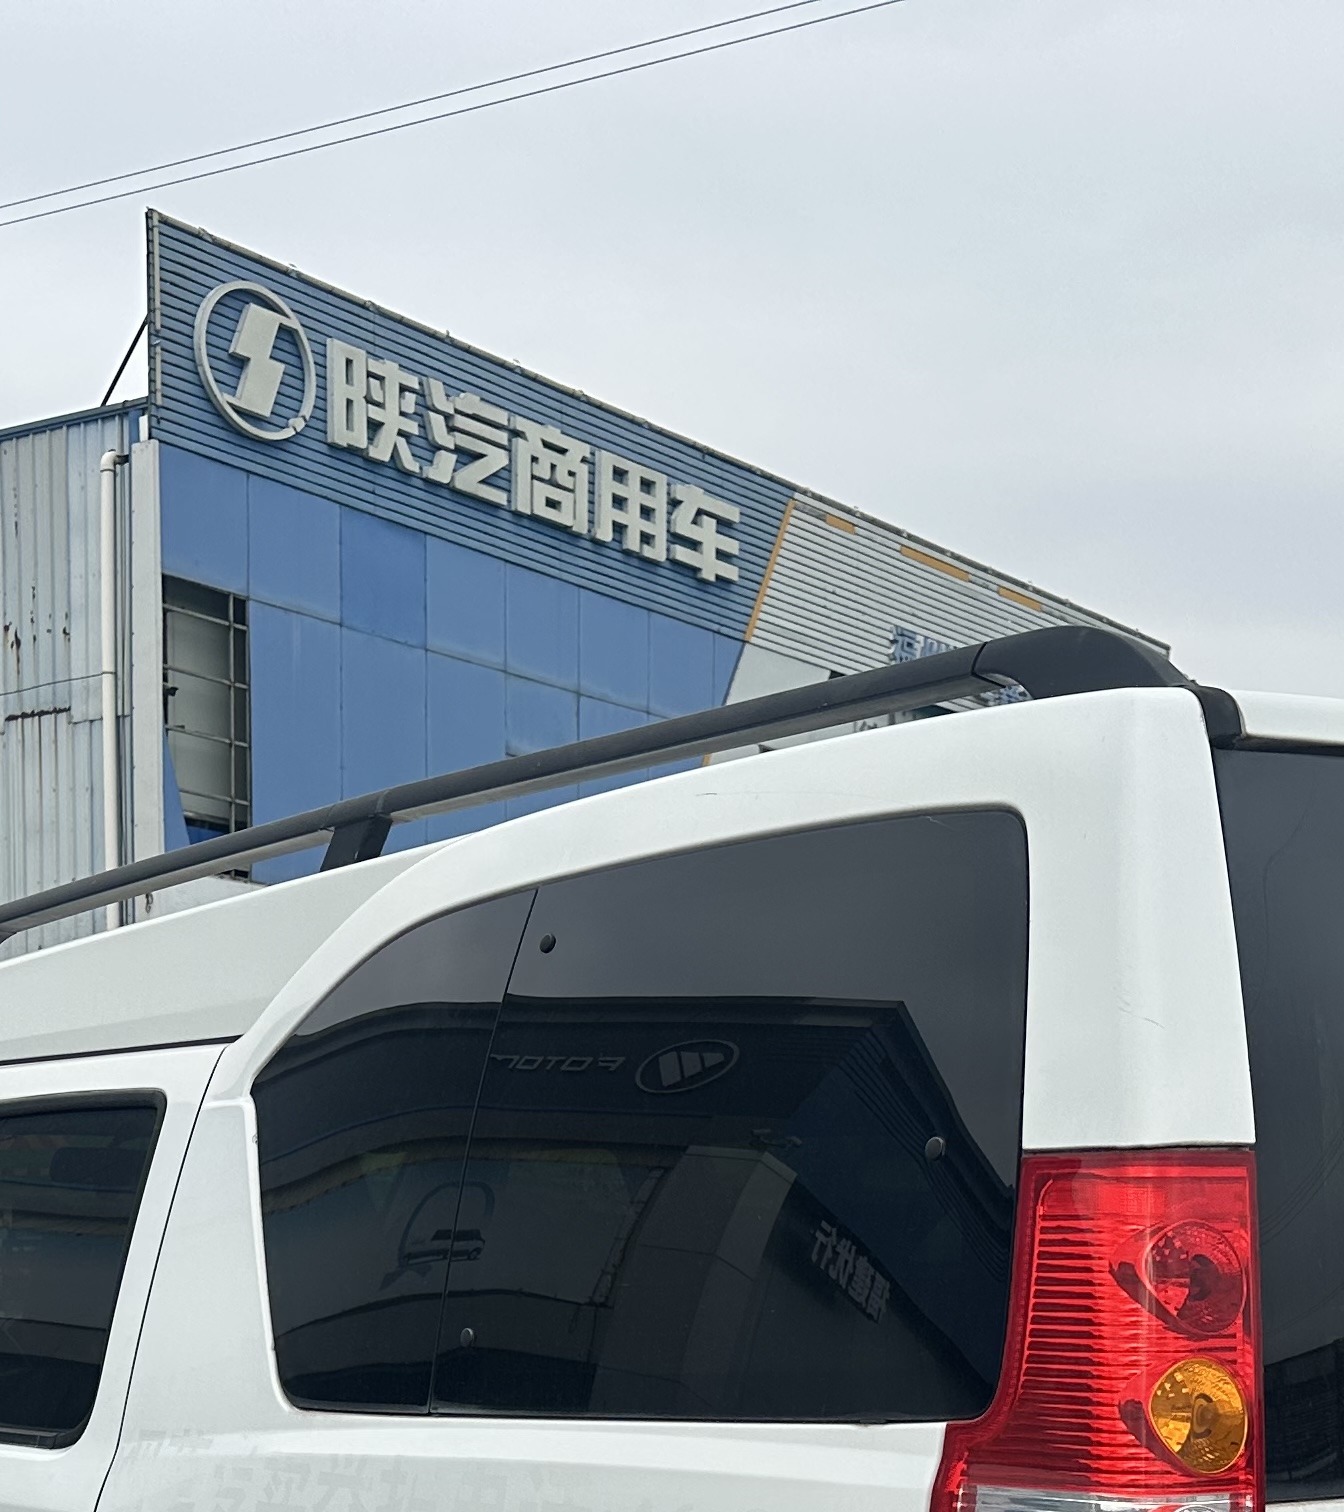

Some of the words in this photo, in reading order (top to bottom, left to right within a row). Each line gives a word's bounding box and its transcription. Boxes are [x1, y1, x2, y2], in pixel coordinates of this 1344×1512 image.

[326, 337, 740, 583] 陕汽商用车
